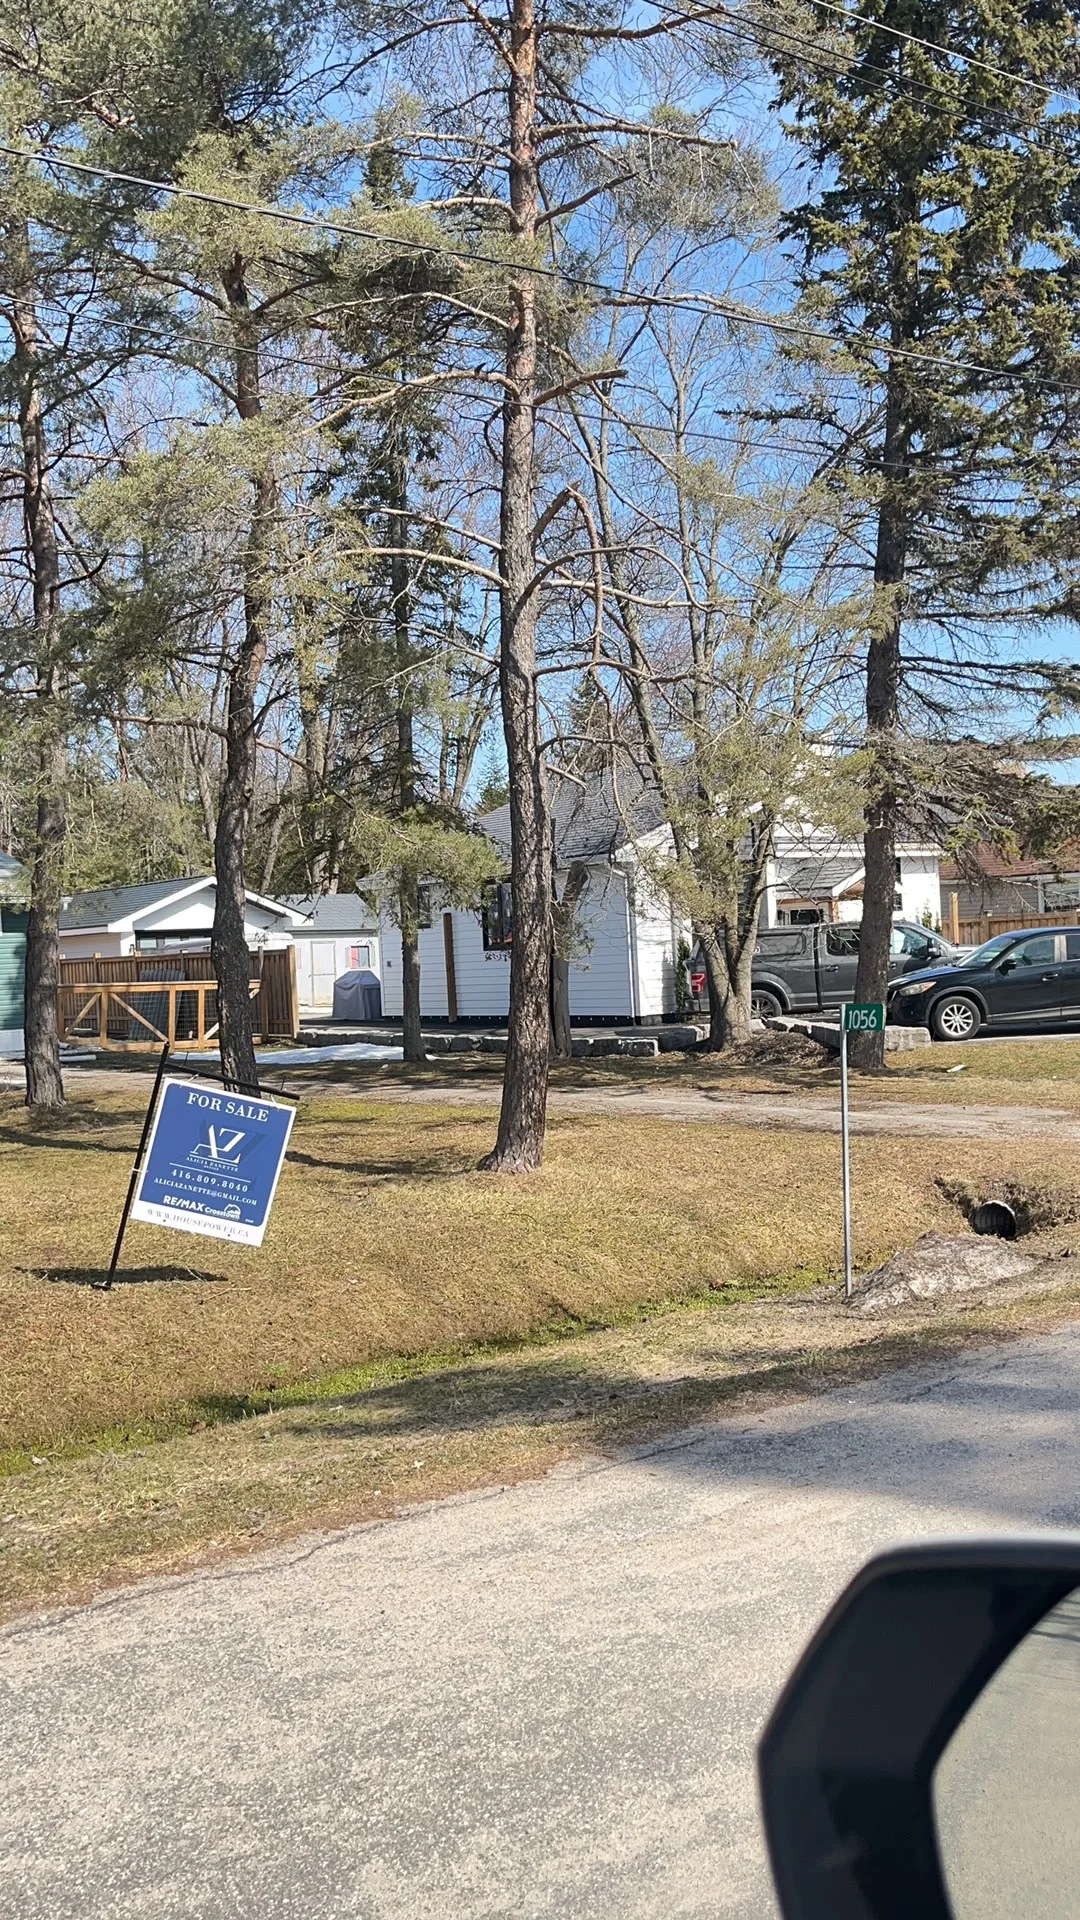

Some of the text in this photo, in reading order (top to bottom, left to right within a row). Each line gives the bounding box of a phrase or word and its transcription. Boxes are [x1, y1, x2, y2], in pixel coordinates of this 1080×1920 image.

[848, 1009, 877, 1029] 1056
[186, 1092, 269, 1122] FOR SALE
[185, 1156, 208, 1166] ALICIA
[209, 1161, 239, 1173] ZANETTE
[153, 1177, 258, 1206] ALICIAZANETTE@GMAIL.COM
[171, 1168, 248, 1193] 416.809.8040
[163, 1195, 240, 1220] RE/MAX Crosstown
[147, 1208, 249, 1238] WWW.HOUSEPOWER.CA
